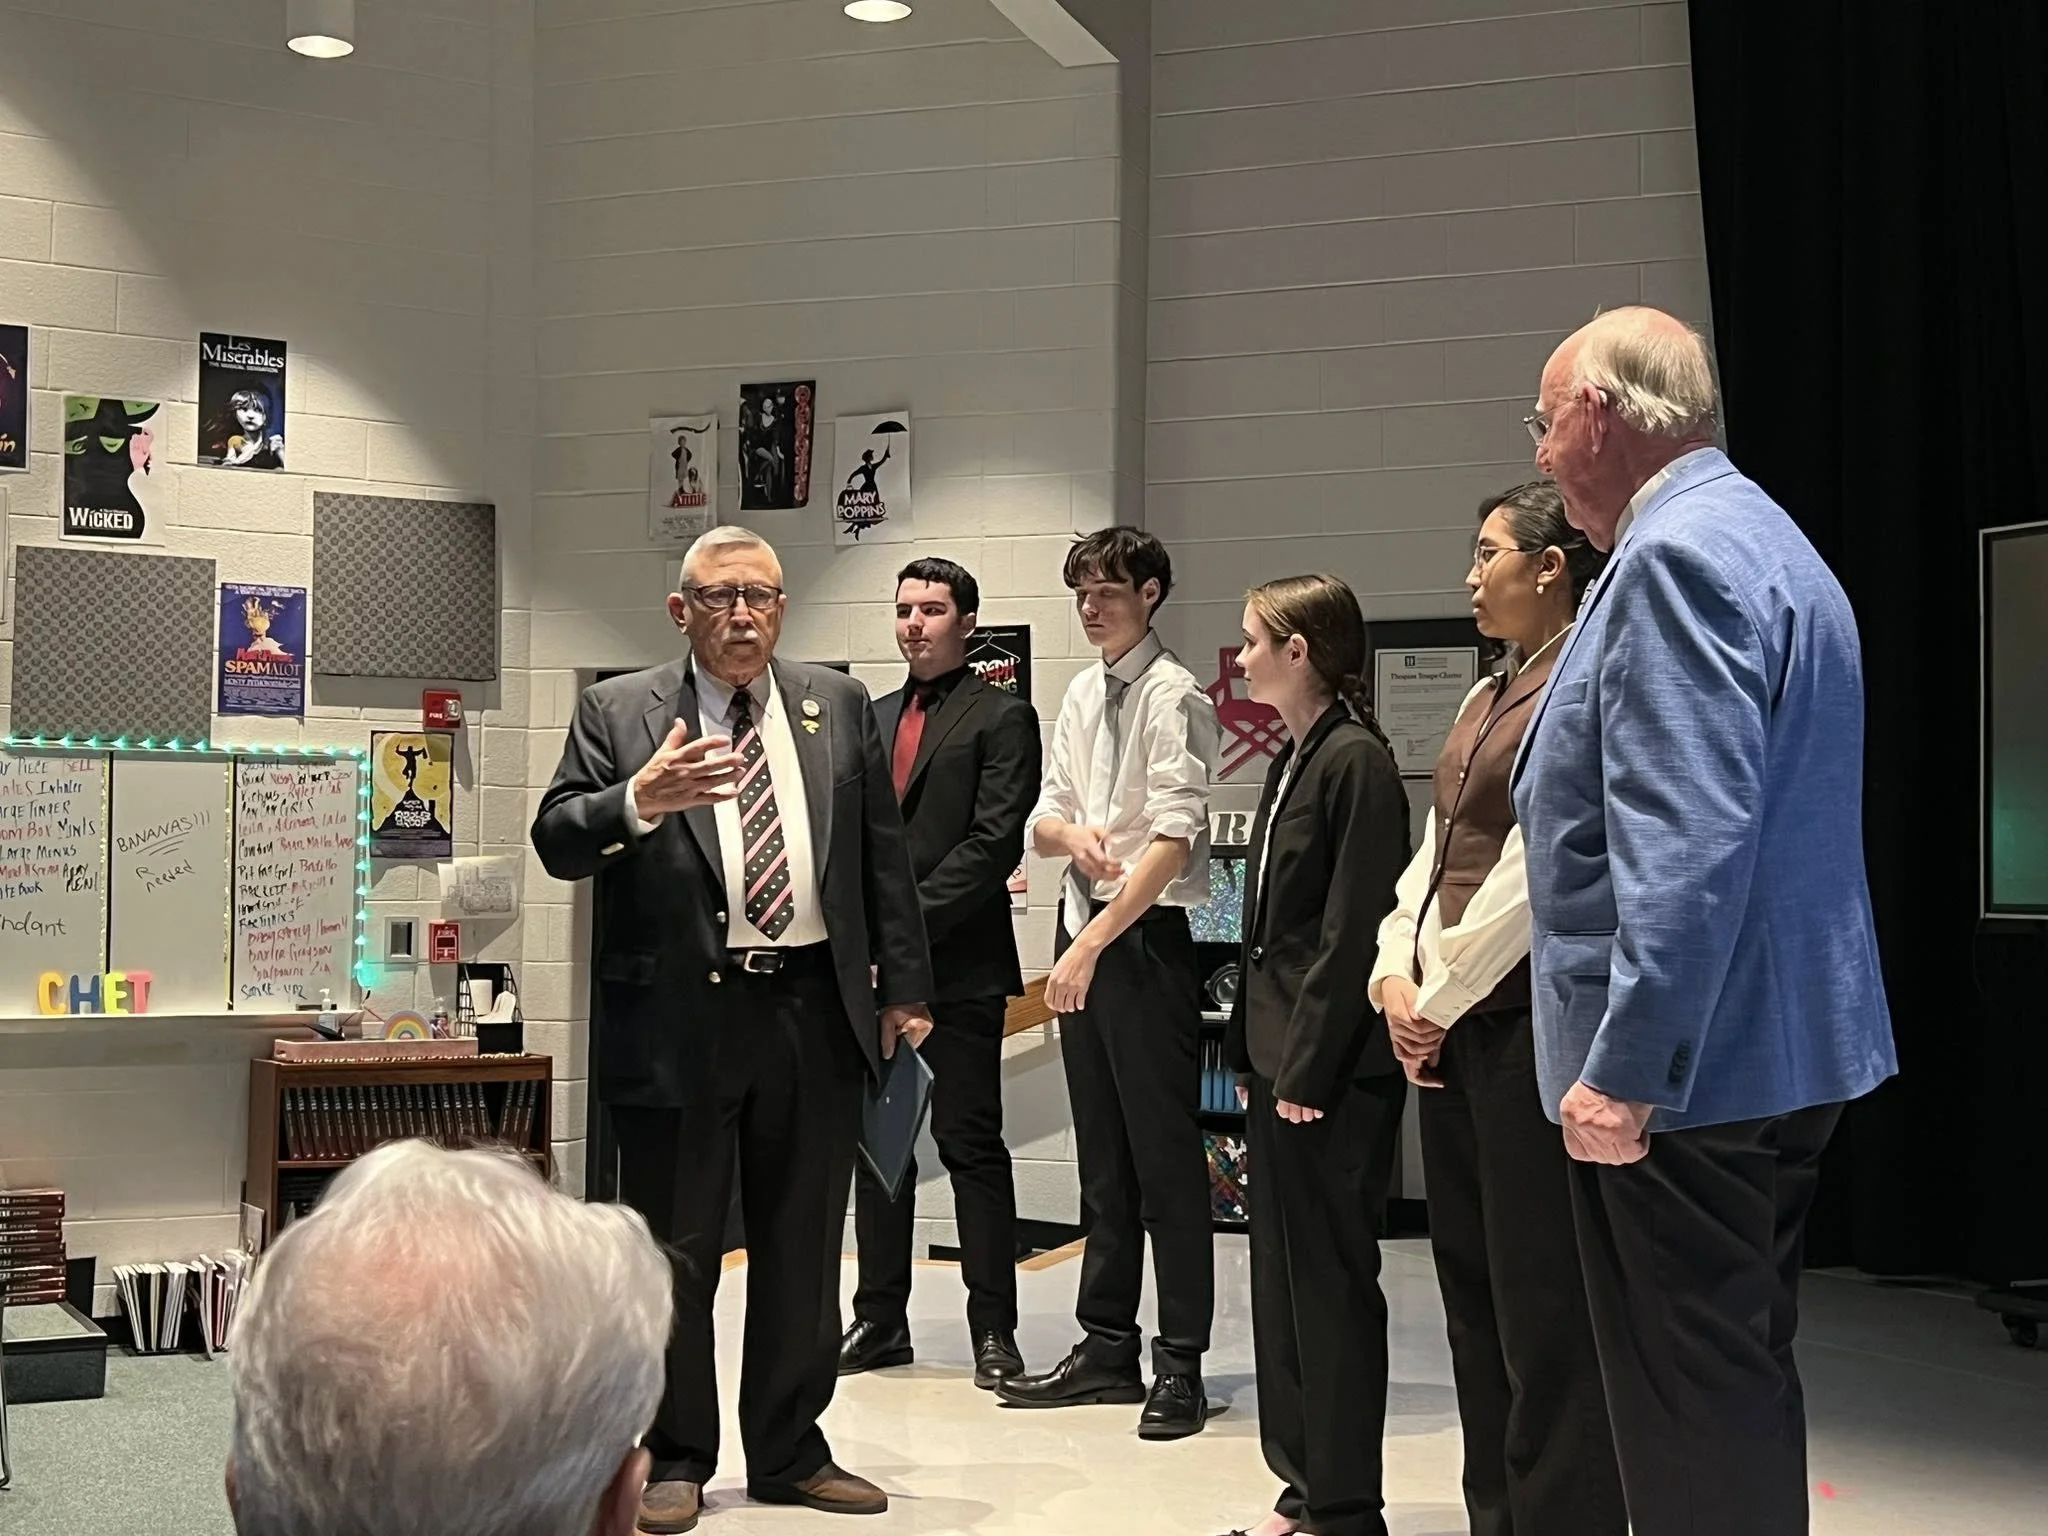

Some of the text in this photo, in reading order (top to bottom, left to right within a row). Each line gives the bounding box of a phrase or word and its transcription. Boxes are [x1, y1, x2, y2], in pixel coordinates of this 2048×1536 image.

[228, 335, 251, 351] Les
[844, 491, 876, 505] MARY
[837, 502, 886, 519] POPPINS
[224, 660, 304, 676] SPAMALOT
[116, 809, 210, 853] BANANAS!!!
[38, 971, 153, 1015] CHET
